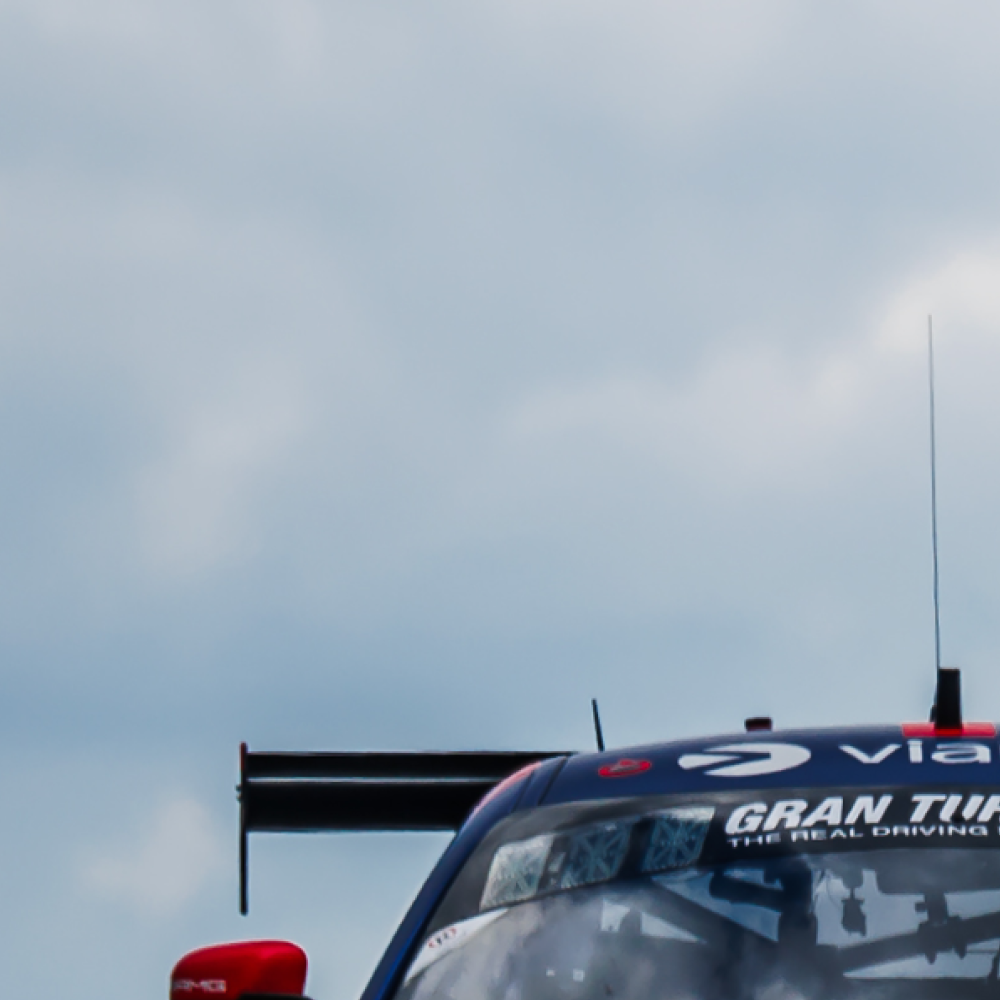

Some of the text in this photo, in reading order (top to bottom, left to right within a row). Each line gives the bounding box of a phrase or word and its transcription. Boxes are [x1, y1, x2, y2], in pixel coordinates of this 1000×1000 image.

[724, 796, 892, 835] GRAN
[727, 834, 783, 848] THE
[790, 829, 864, 843] REAL
[871, 826, 990, 839] DRIVING
